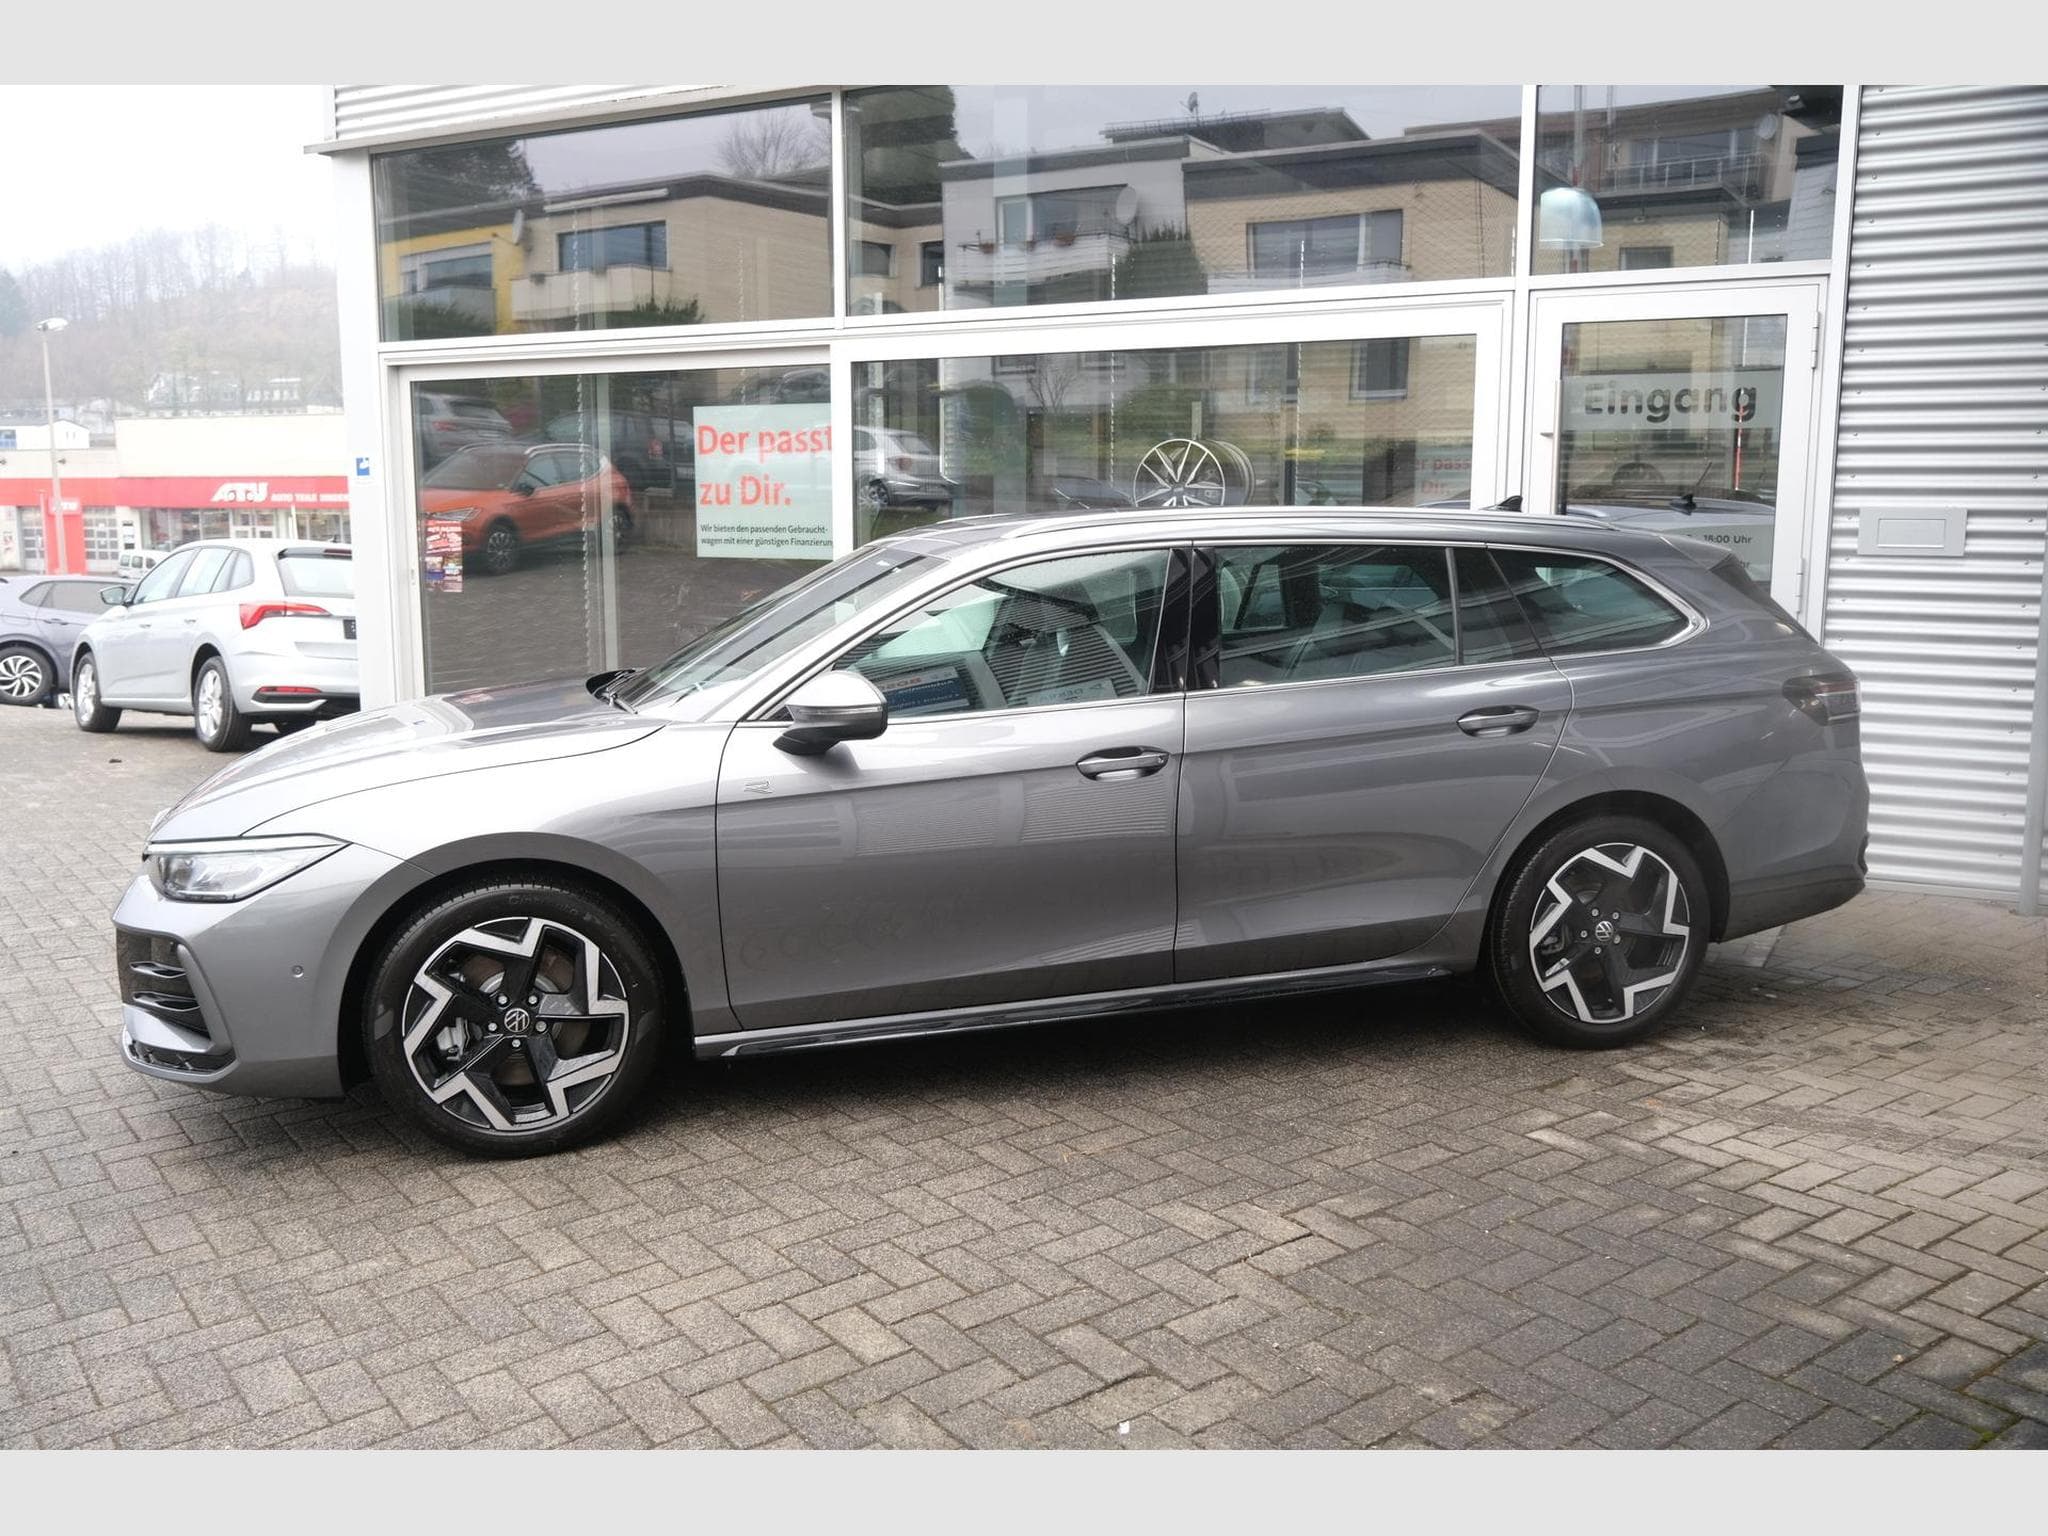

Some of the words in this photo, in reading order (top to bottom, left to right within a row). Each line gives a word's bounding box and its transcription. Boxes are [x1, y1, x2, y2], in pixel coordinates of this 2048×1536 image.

[1585, 380, 1757, 423] Eingang
[698, 424, 749, 455] Der
[699, 482, 731, 506] zu
[740, 473, 794, 506] Dir.
[700, 524, 713, 533] Wir
[713, 524, 735, 533] bieten
[736, 524, 750, 533] den
[750, 524, 787, 535] passenden
[787, 524, 828, 535] Gebraucht-
[1733, 533, 1753, 544] Uhr
[701, 537, 722, 547] wagen
[723, 536, 735, 546] mit
[736, 536, 753, 546] einer
[754, 536, 790, 548] günstigen
